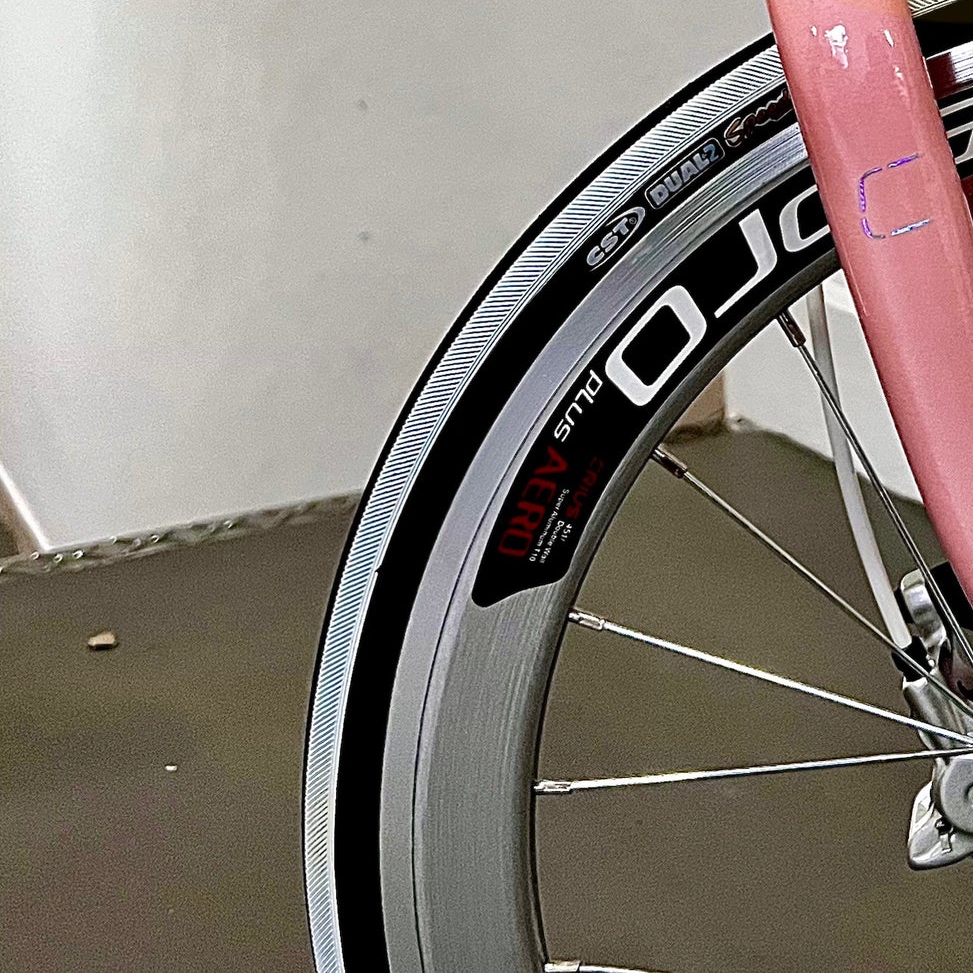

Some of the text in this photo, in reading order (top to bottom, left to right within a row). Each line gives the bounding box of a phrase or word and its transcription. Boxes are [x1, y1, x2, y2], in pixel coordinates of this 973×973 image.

[586, 217, 630, 266] CST
[498, 445, 569, 558] AERO
[555, 488, 570, 510] Super
